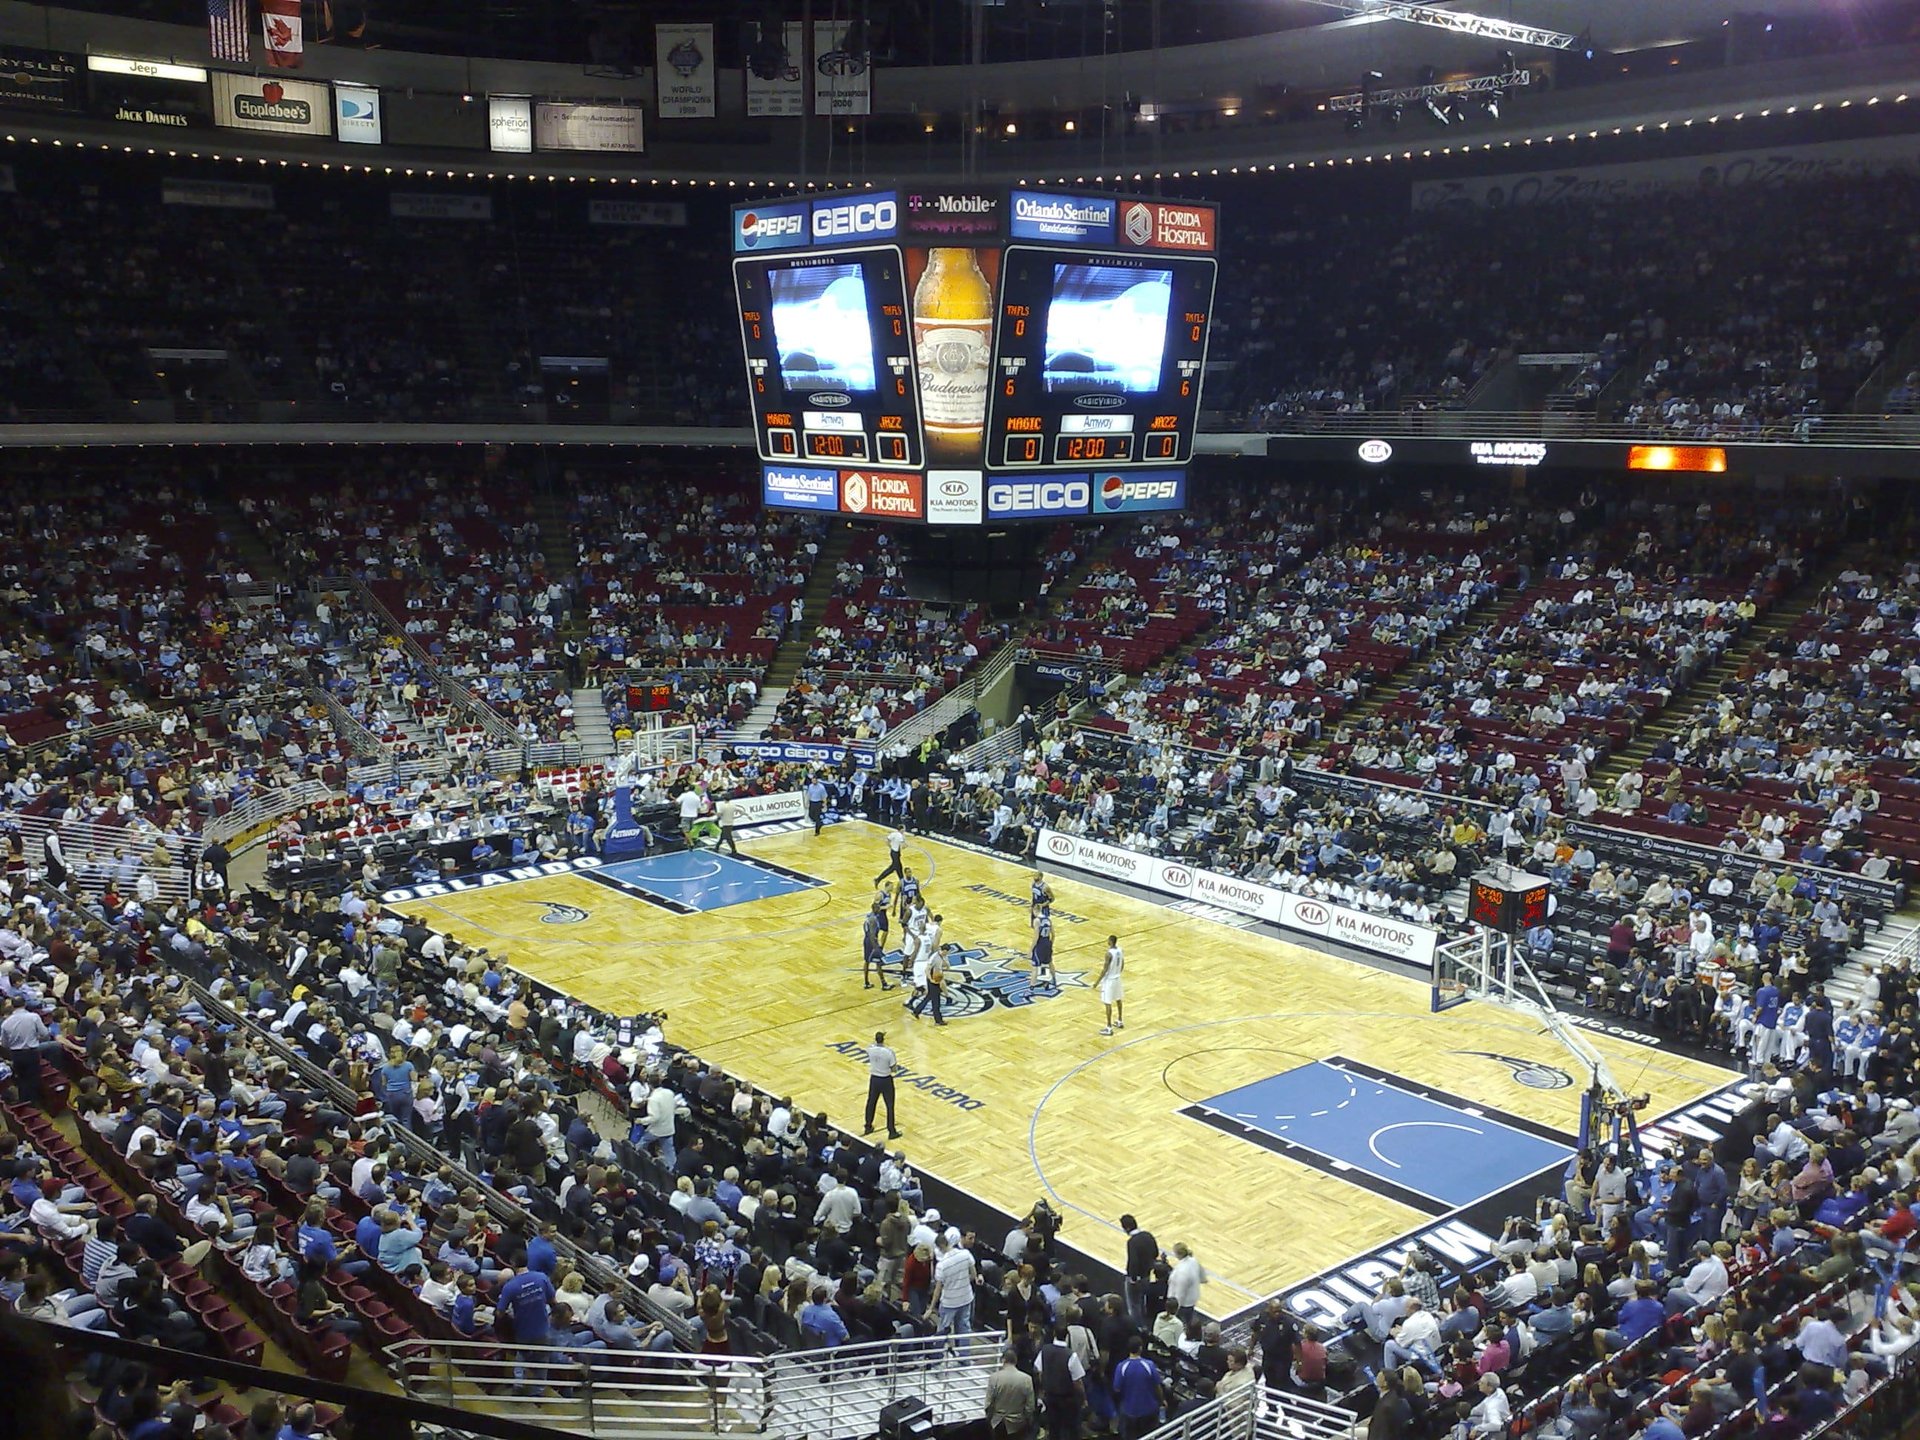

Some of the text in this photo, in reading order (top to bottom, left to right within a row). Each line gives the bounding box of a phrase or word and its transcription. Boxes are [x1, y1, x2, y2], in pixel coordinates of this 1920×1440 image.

[129, 62, 158, 76] Jeep
[115, 107, 188, 127] JACK DANIEL'S
[239, 101, 307, 120] Applebee's
[342, 120, 375, 128] DIRECTV
[491, 116, 529, 131] spherion
[812, 200, 897, 237] GEICO
[1016, 198, 1110, 222] Orlando Sentinel
[1158, 207, 1201, 227] FLORIDA
[756, 214, 803, 237] PEPSI
[1158, 225, 1208, 246] HOSPITAL
[1088, 258, 1143, 267] MULTIMEDIA
[752, 324, 760, 339] 0
[892, 319, 901, 336] 0
[1015, 319, 1025, 336] 0
[1191, 325, 1200, 341] 0
[1005, 366, 1018, 375] LEFT
[756, 378, 764, 392] 6
[895, 378, 905, 395] 6
[919, 372, 987, 393] Budweiser
[1005, 378, 1015, 395] 6
[1181, 380, 1190, 396] 6
[1077, 396, 1123, 406] MAGICVISION
[766, 413, 792, 426] MAGIC
[821, 413, 844, 427] Amway
[879, 416, 903, 429] JAZZ
[1007, 417, 1042, 431] MAGIC
[1083, 415, 1113, 430] Amway
[1151, 415, 1178, 429] JAZZ
[783, 433, 792, 453] 0
[814, 435, 844, 455] 12:00
[893, 439, 902, 458] 0
[1025, 439, 1036, 459] 0
[1068, 438, 1105, 458] 12:00
[1162, 436, 1173, 456] 0
[1494, 442, 1547, 457] MOTORS
[767, 472, 834, 492] Orlando Sentinel
[871, 476, 910, 495] FLORIDA
[945, 484, 964, 492] KIA
[988, 482, 1090, 512] GEICO
[1122, 481, 1178, 501] PEPSI
[871, 494, 917, 513] HOSPITAL
[930, 499, 978, 507] KIA MOTORS
[1036, 665, 1061, 675] BUD
[784, 748, 830, 758] GEICO
[749, 805, 764, 813] KIA
[766, 799, 801, 810] MOTORS
[610, 828, 641, 839] Amway
[1052, 841, 1069, 852] KIA
[1078, 846, 1137, 871] KIA MOTORS
[381, 856, 603, 902] ORLANDO
[1167, 870, 1187, 884] KIA
[1198, 878, 1264, 905] KIA MOTORS
[1211, 895, 1228, 905] Power
[1234, 900, 1257, 912] Surprise
[1301, 905, 1323, 922] KIA
[1336, 914, 1415, 946] KIA MOTORS
[1340, 931, 1351, 939] The
[1351, 933, 1371, 945] Power
[1378, 940, 1406, 954] Surprise
[903, 1075, 987, 1111] Arena
